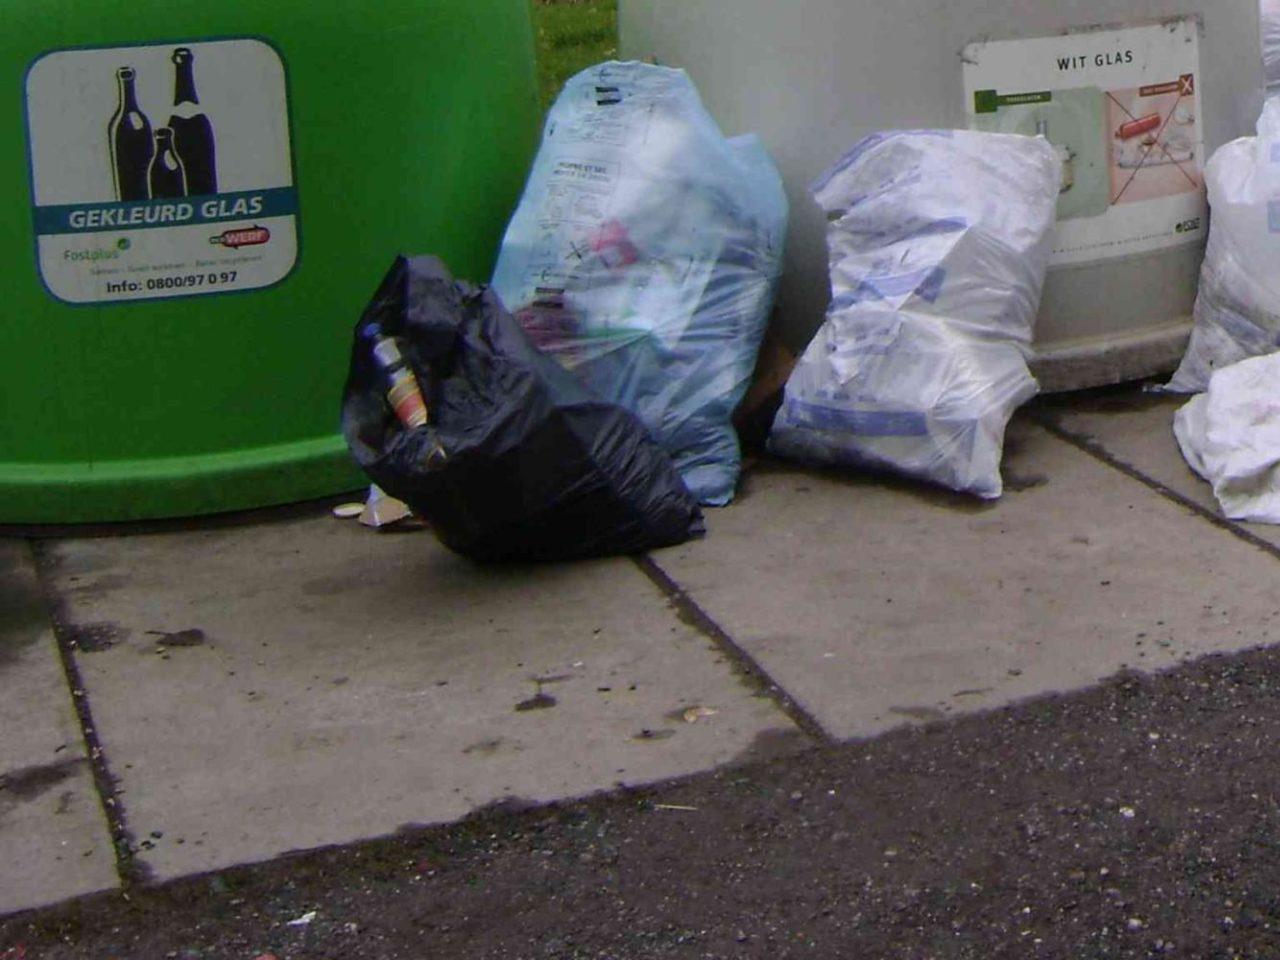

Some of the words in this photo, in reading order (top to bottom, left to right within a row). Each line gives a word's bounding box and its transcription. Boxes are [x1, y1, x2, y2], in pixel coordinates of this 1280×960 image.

[1057, 55, 1087, 71] WIT
[1094, 50, 1134, 67] GLAS
[68, 202, 194, 229] GEKLEURD
[200, 196, 264, 219] GLAS
[106, 278, 143, 294] Info:
[146, 274, 205, 291] 0800/97
[208, 273, 217, 285] 0
[219, 271, 238, 284] 97
